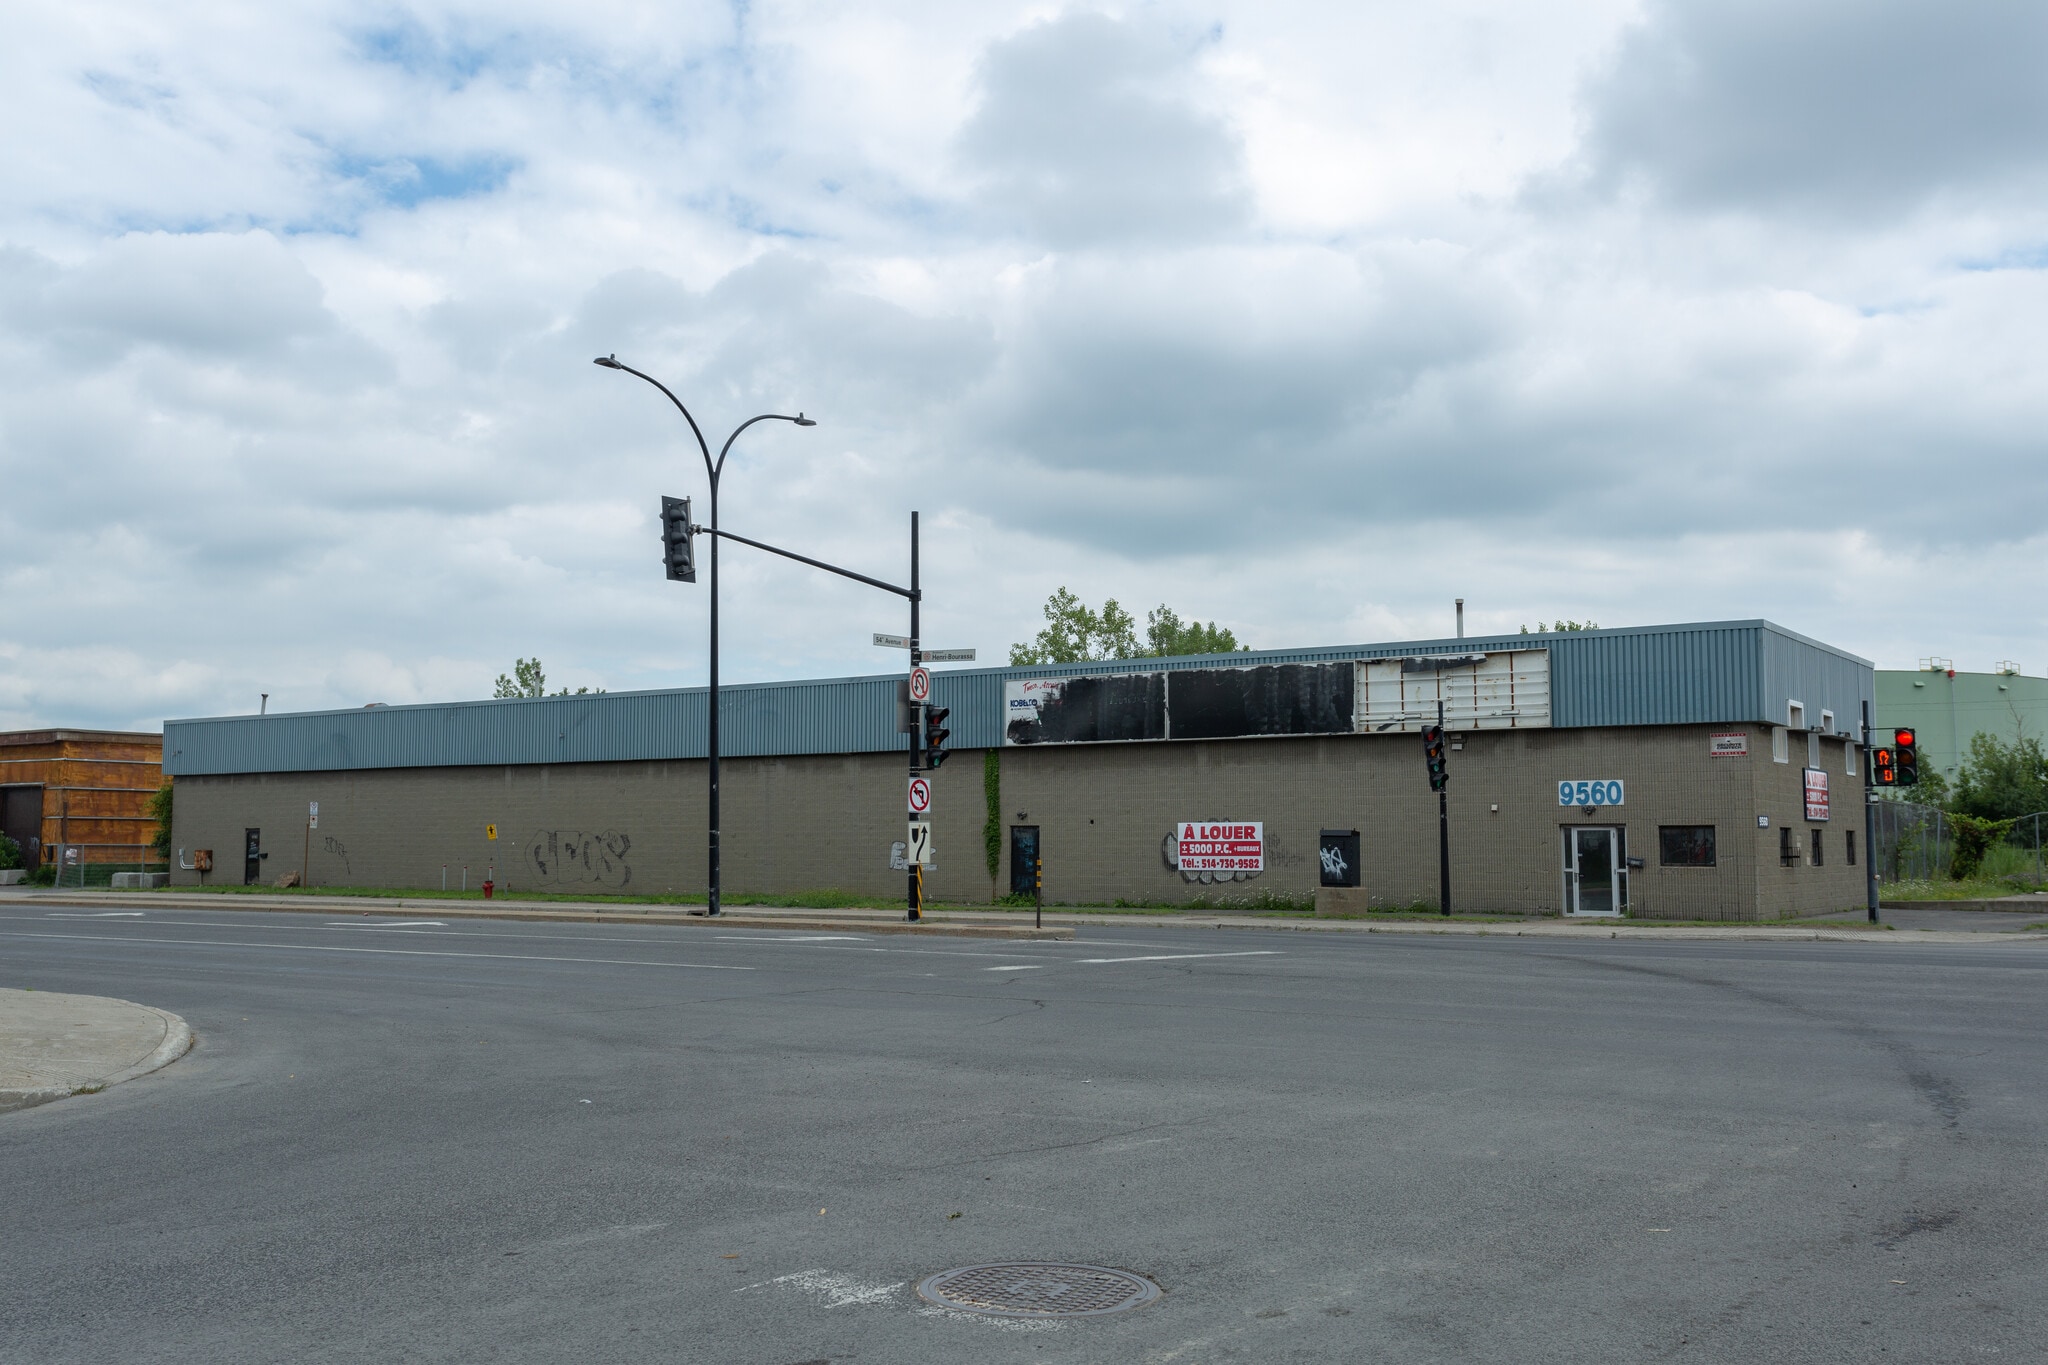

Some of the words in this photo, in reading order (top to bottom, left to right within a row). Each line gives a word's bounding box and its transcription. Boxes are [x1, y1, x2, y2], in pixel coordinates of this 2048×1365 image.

[885, 638, 901, 646] Avenue
[1560, 781, 1622, 805] 9560
[1183, 824, 1195, 839] À
[1200, 825, 1256, 839] LOUER
[1189, 844, 1213, 854] 5000
[1214, 844, 1232, 854] P.C.
[1181, 858, 1200, 869] Tél.:
